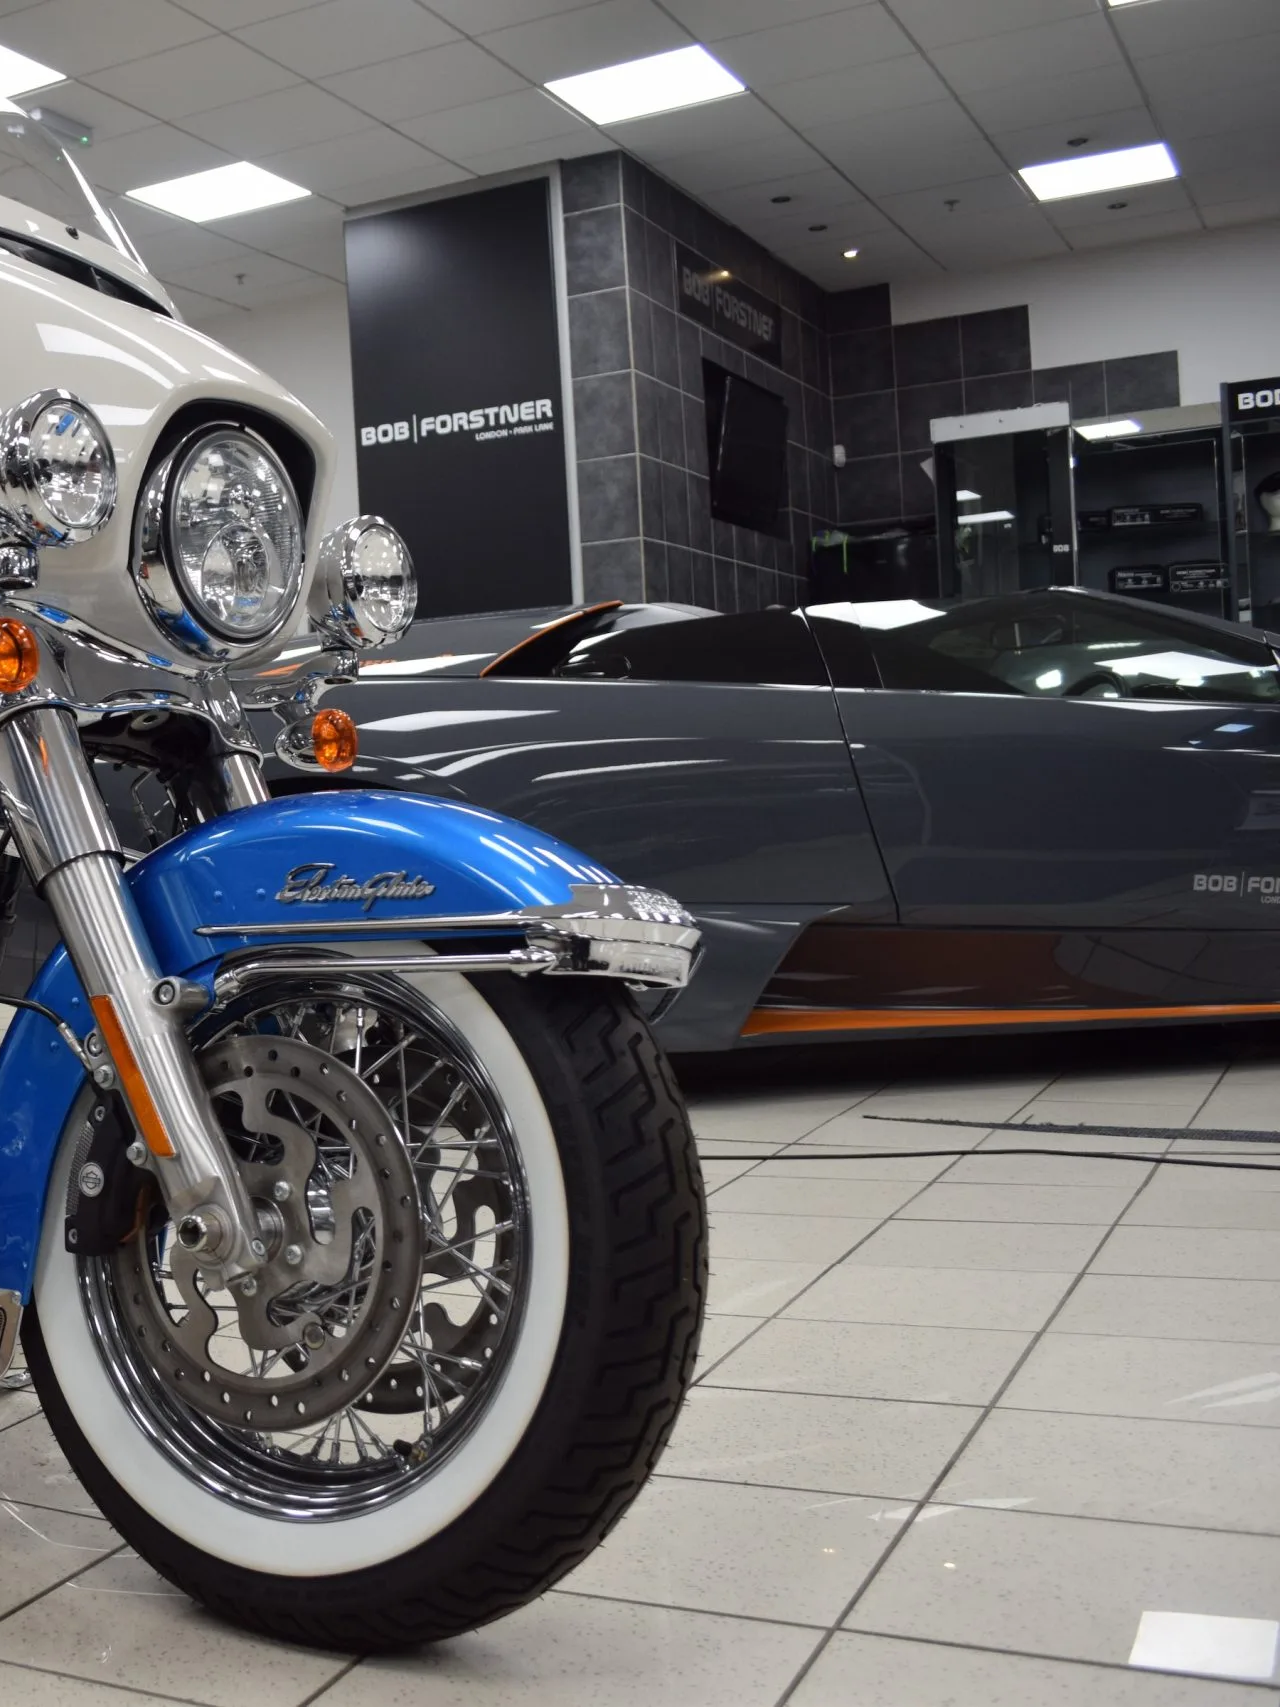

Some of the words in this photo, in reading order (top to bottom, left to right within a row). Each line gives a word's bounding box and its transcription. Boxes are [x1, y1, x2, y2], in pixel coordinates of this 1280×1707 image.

[682, 265, 710, 307] BOB
[361, 421, 410, 446] BOB
[420, 398, 553, 436] FORSTNER
[475, 429, 508, 441] LONDON
[1193, 874, 1237, 892] BOB
